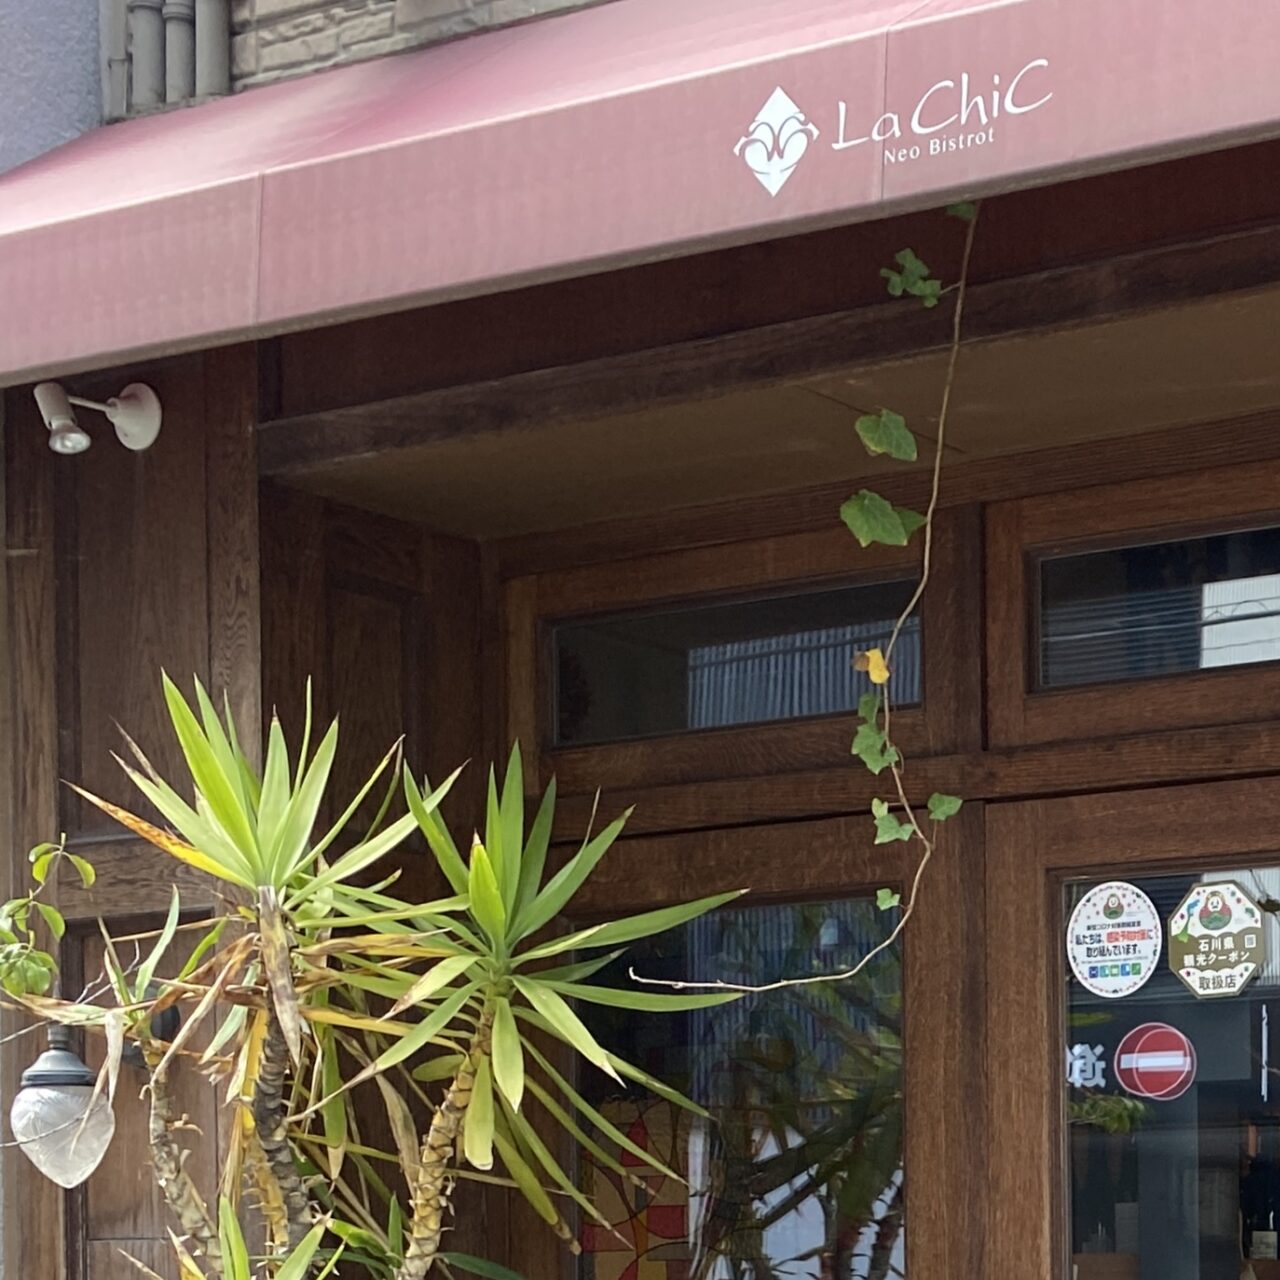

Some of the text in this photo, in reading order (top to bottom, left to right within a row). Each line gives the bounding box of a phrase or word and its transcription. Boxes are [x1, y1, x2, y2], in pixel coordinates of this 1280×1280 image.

[883, 126, 995, 165] Neo Bistrot
[1199, 936, 1234, 952] 石川県
[1183, 951, 1250, 967] 観光クーポン
[1198, 974, 1237, 991] 取扱店
